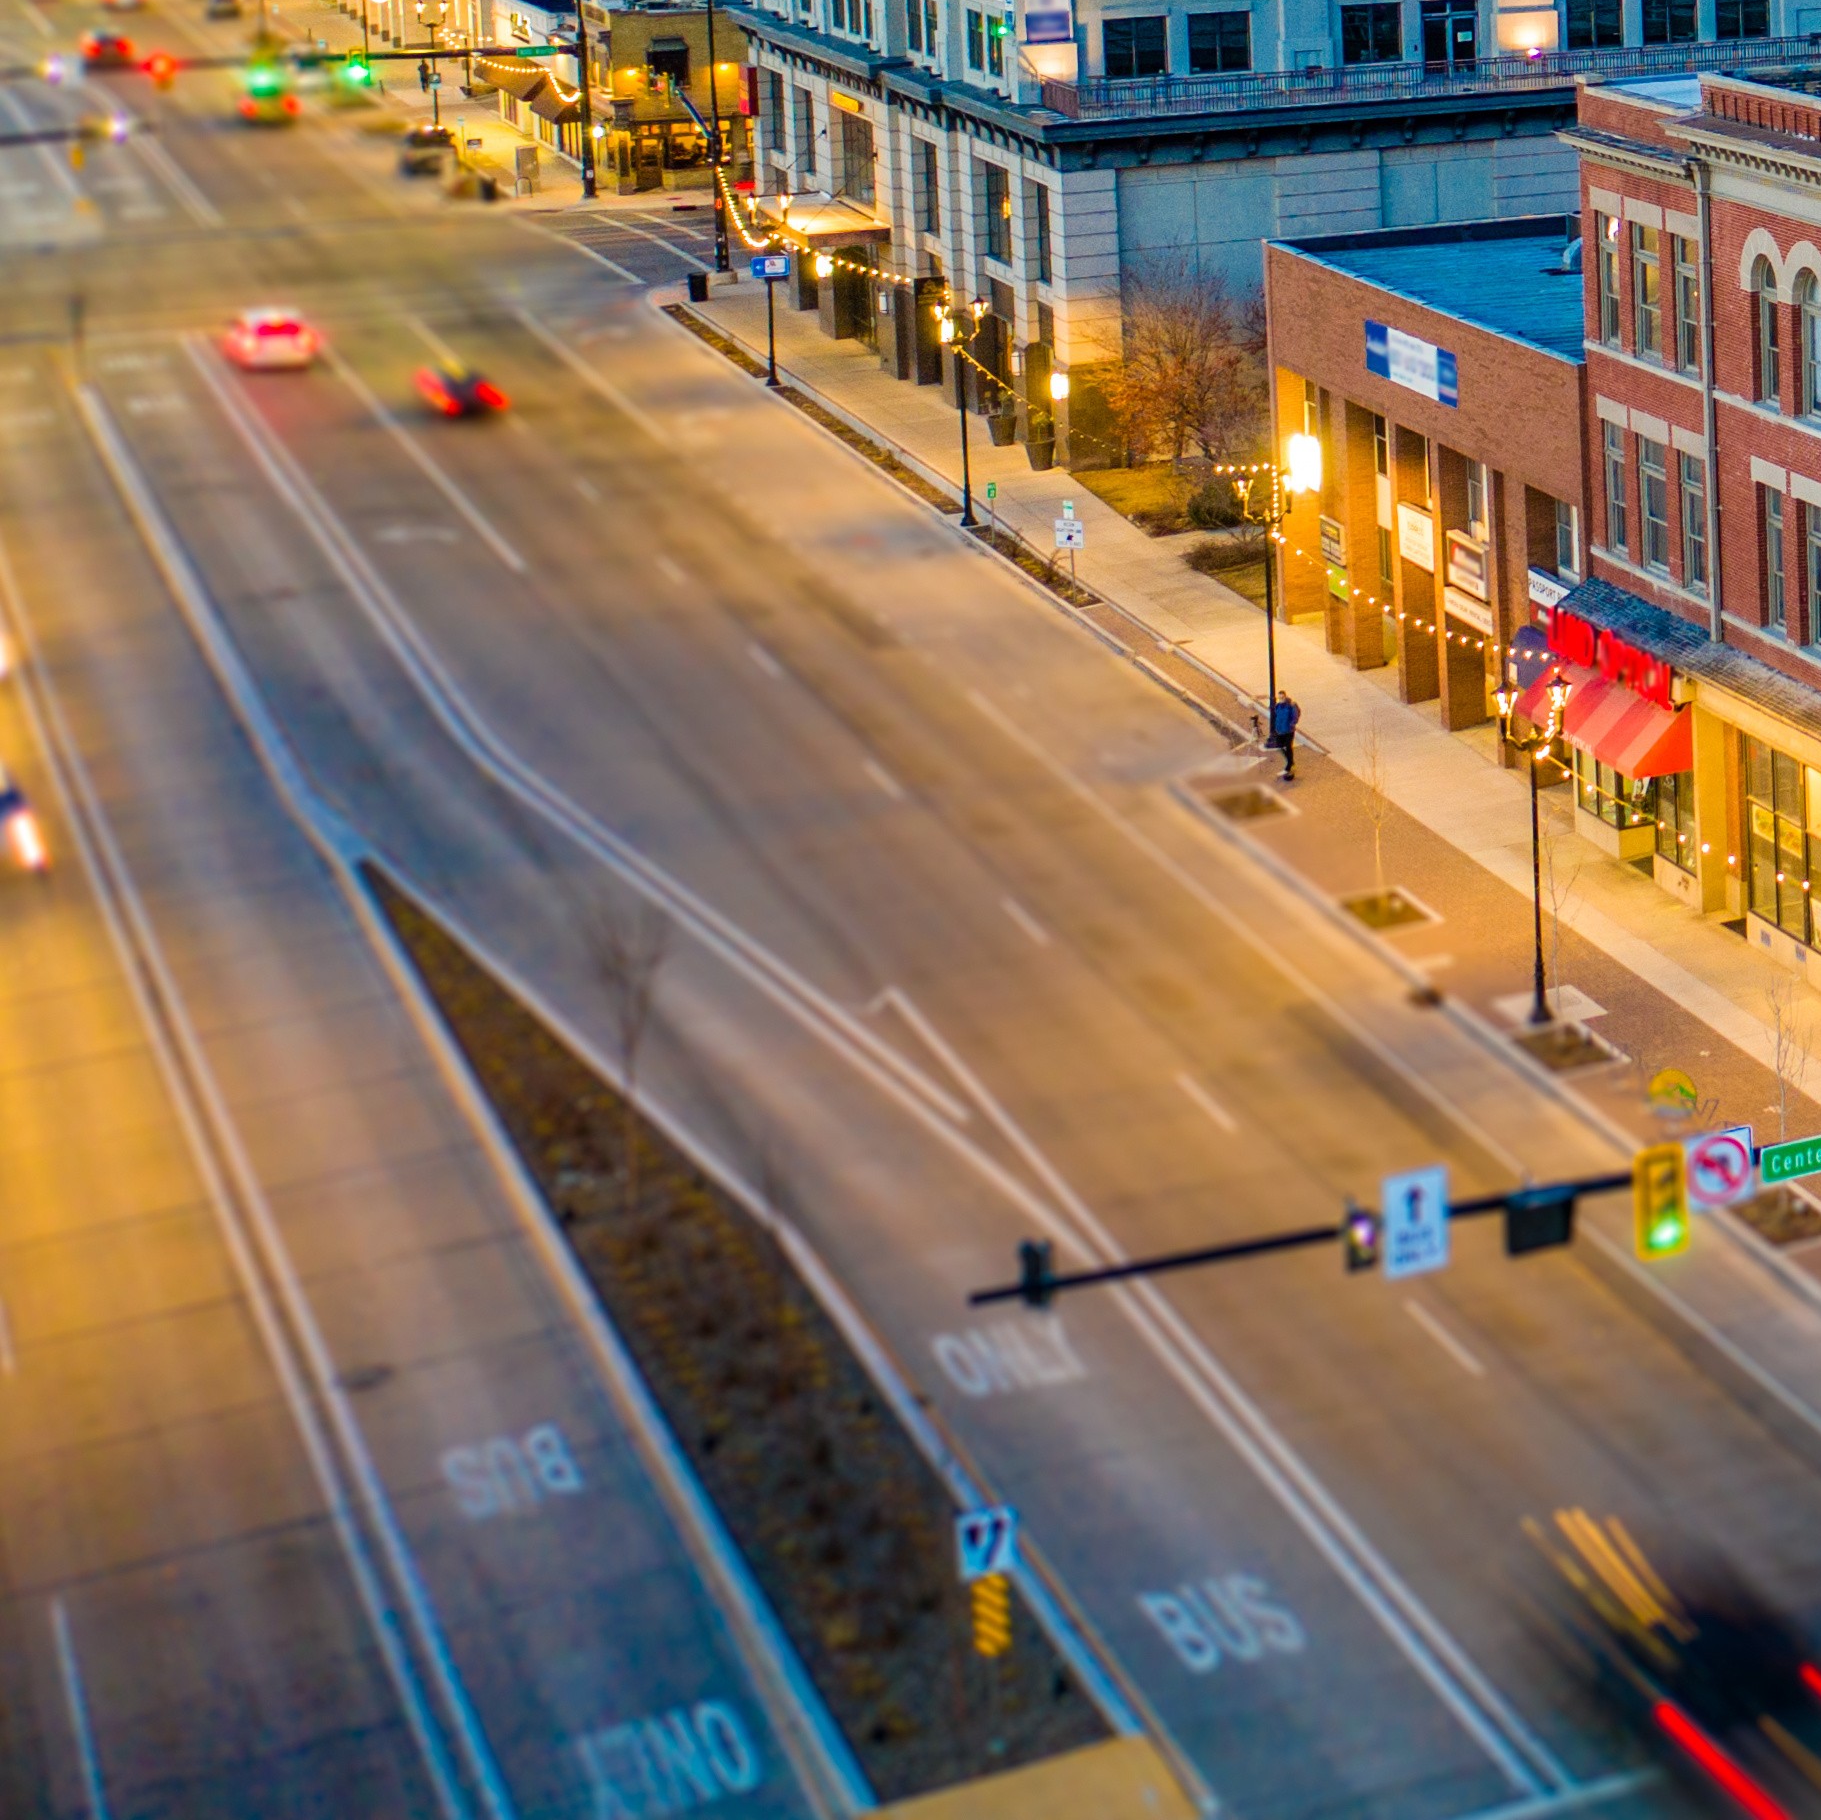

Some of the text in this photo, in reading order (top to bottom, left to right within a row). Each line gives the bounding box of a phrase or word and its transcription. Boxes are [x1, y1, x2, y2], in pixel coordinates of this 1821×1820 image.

[931, 1312, 1087, 1398] ONLY
[440, 1421, 584, 1522] BUS
[1137, 1572, 1307, 1673] BUS
